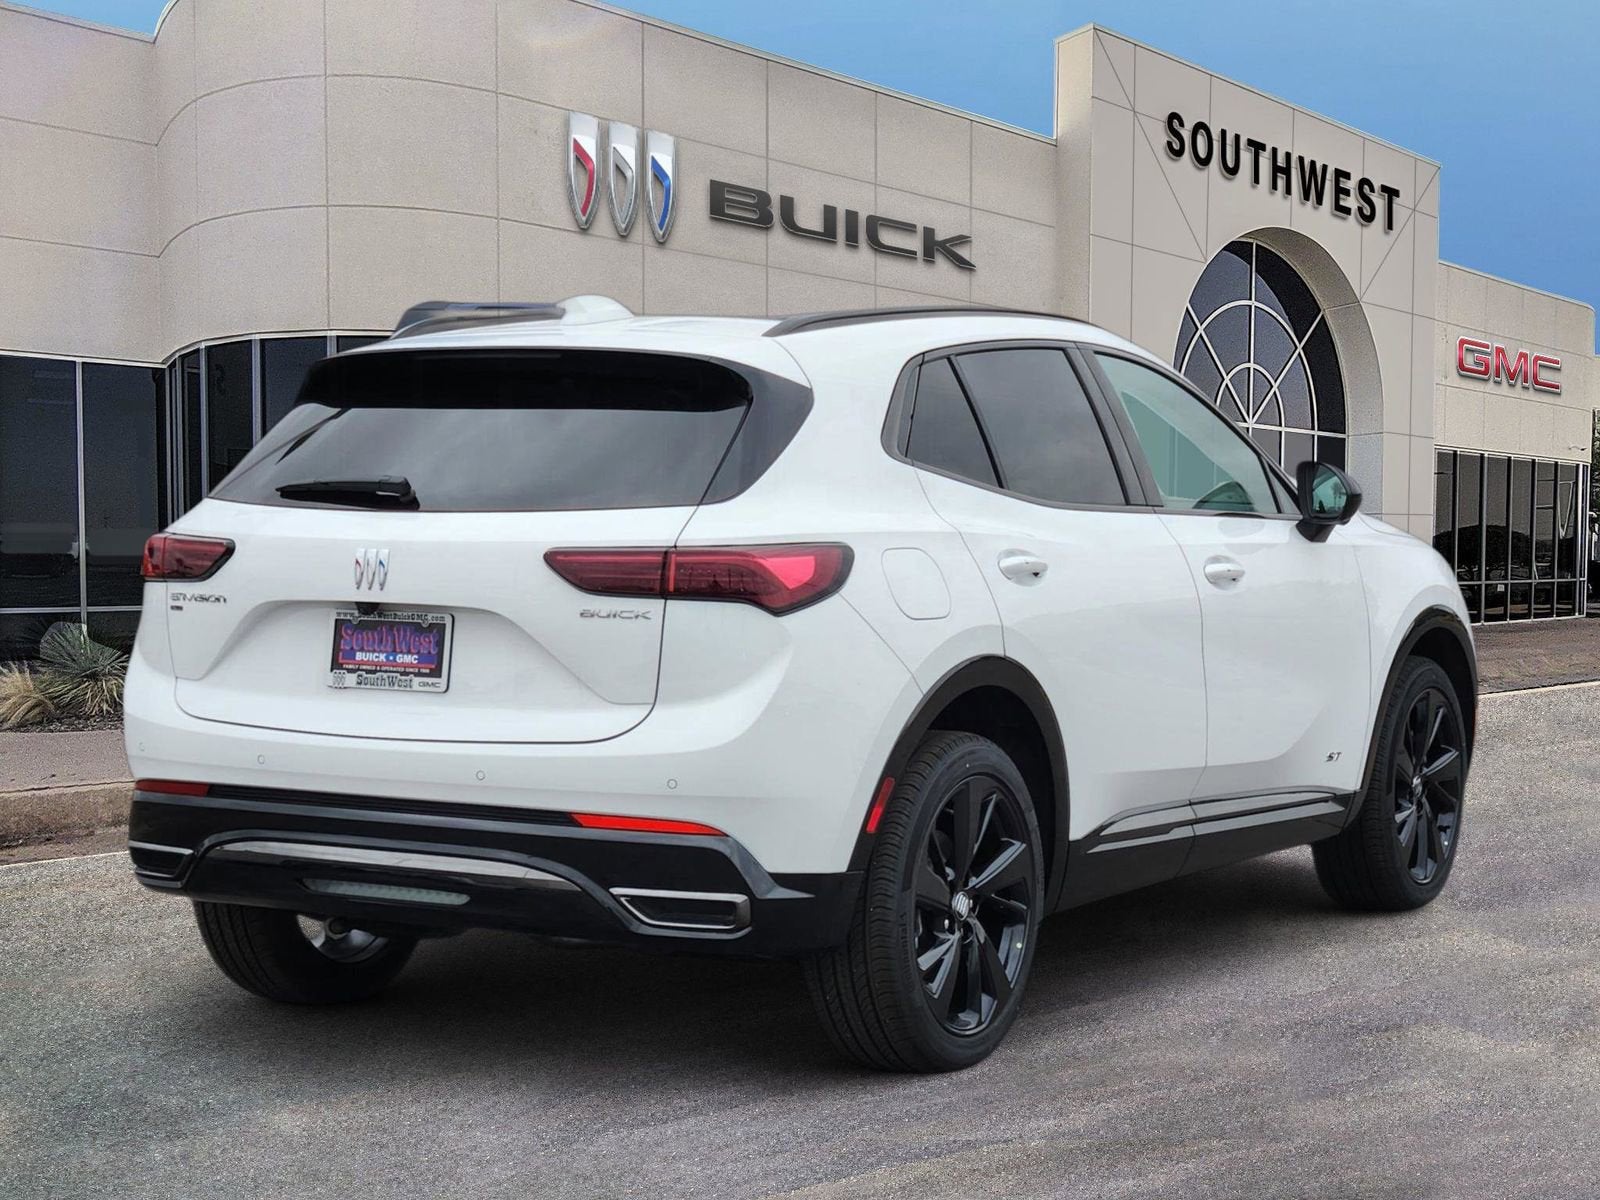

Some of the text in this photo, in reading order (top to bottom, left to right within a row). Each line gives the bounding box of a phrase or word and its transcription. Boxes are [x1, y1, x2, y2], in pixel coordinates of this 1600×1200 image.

[1165, 111, 1400, 232] SOUTHWEST
[708, 178, 977, 271] BUICK
[1456, 335, 1561, 395] GMC
[579, 608, 652, 620] BUICK
[340, 623, 440, 655] SouthWest
[355, 652, 419, 664] BUICK GMC
[356, 674, 414, 689] SouthWest
[1325, 751, 1342, 762] ST
